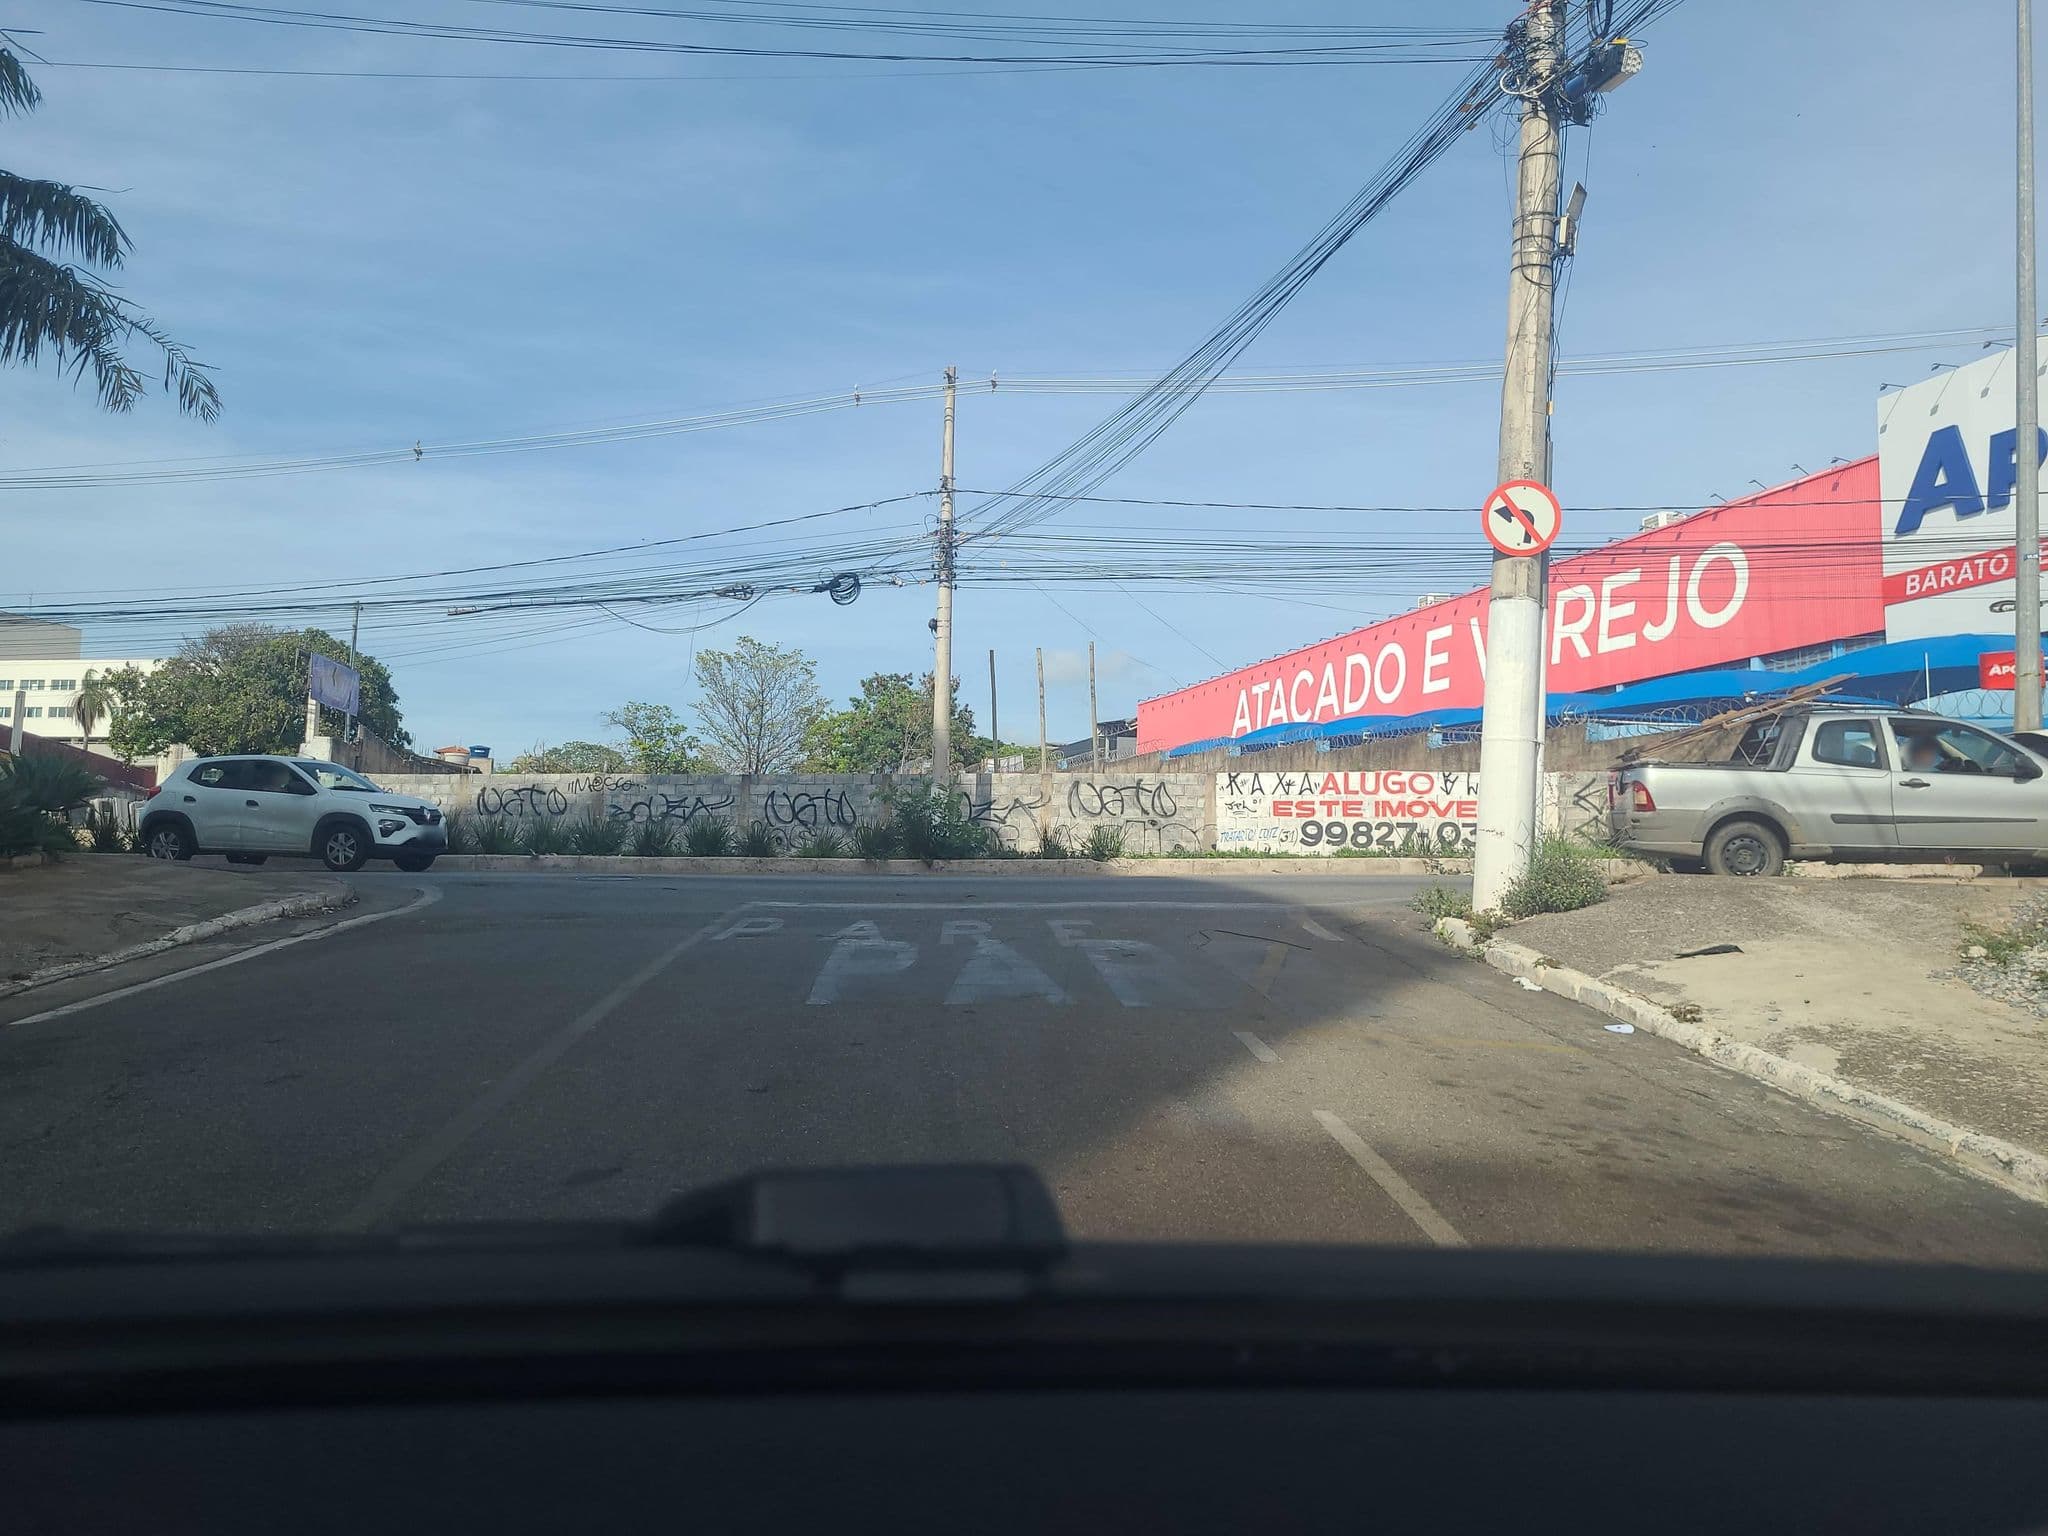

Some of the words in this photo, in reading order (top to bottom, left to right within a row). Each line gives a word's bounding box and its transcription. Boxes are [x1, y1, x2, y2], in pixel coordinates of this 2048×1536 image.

[1905, 553, 2009, 596] BARATO
[1231, 643, 1406, 737] ATACADO
[1422, 624, 1452, 694] E
[1470, 542, 1748, 683] VREJO
[1320, 770, 1434, 795] ALUGO
[1272, 800, 1363, 818] ESTE
[1375, 796, 1477, 818] IMÓVE
[1300, 820, 1477, 849] 99827-03
[710, 918, 1094, 947] PARE
